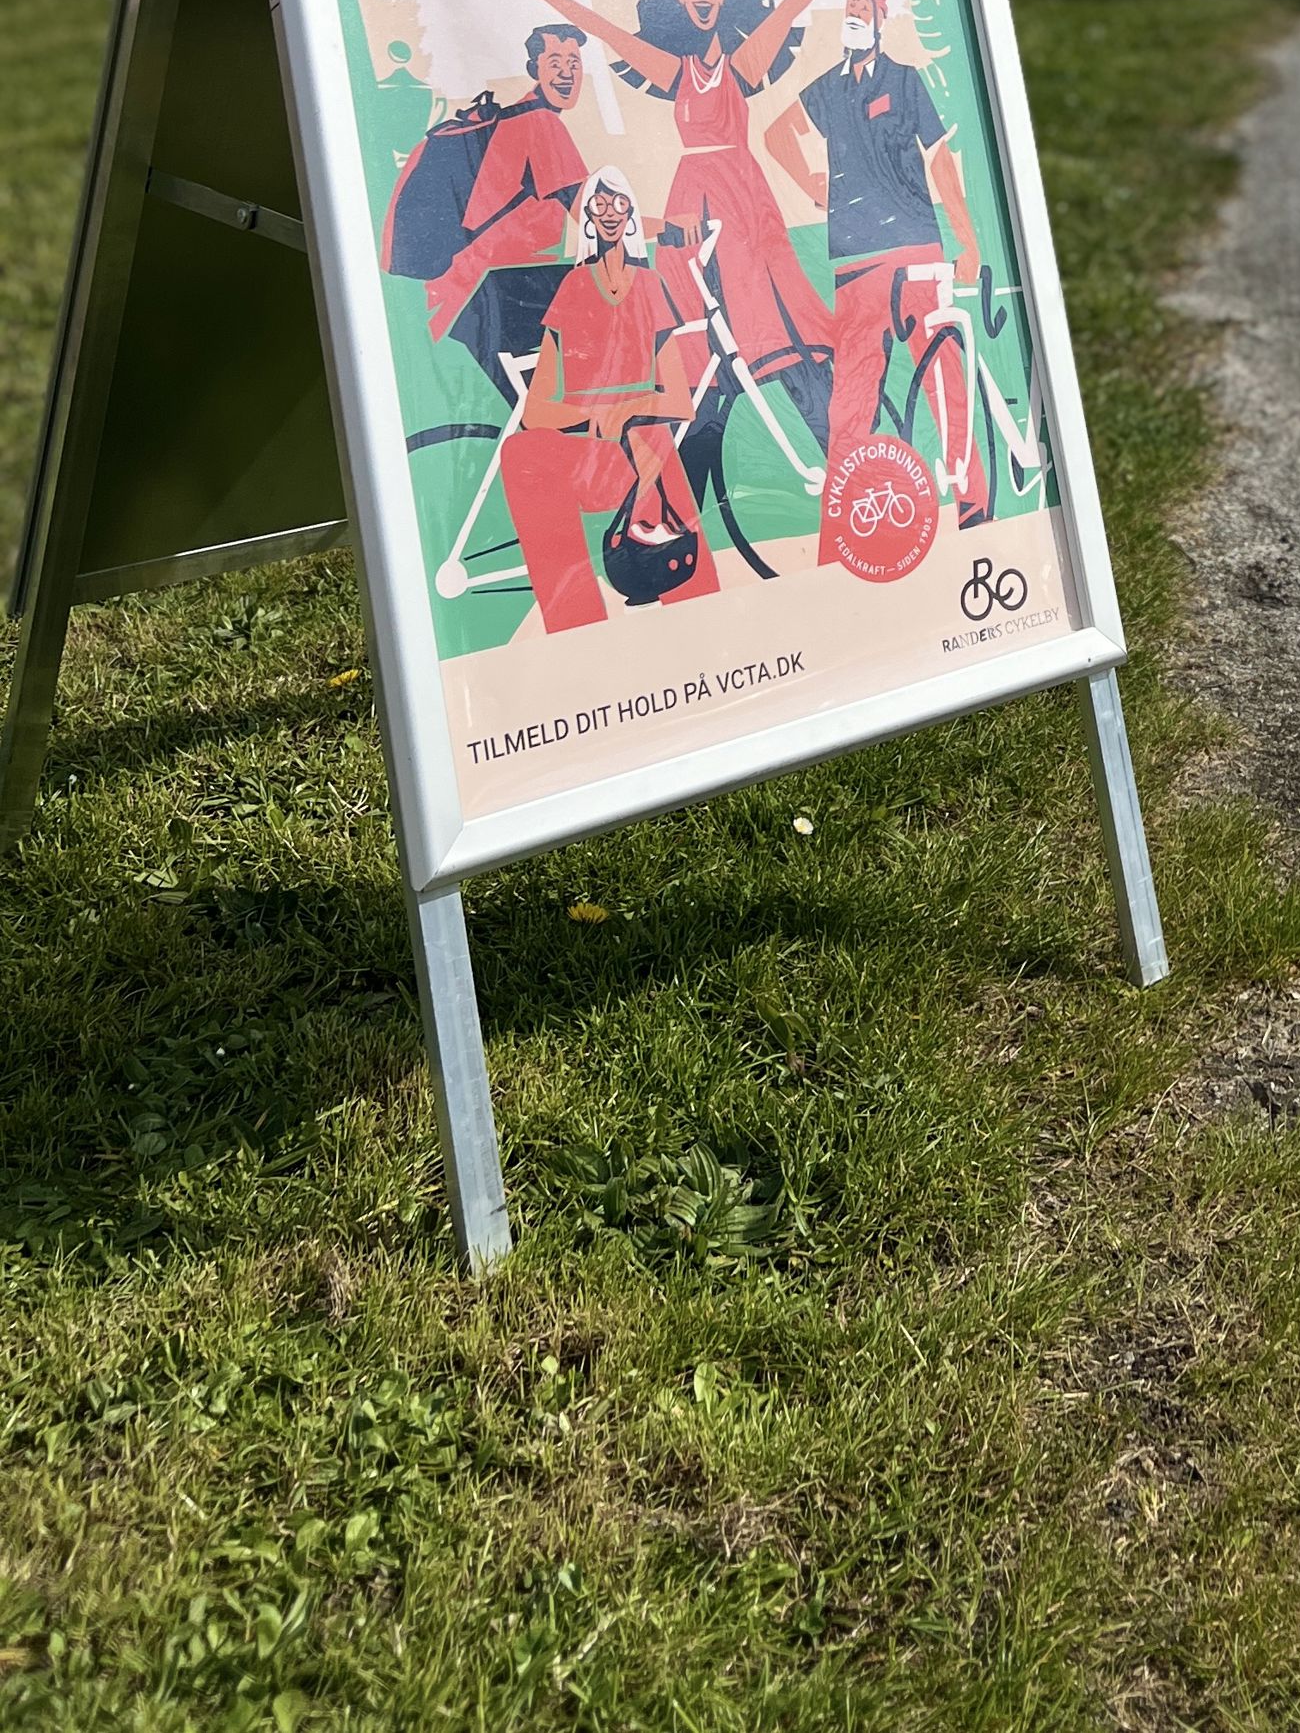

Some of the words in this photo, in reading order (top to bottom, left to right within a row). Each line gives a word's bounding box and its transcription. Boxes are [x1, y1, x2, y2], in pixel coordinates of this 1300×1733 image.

[828, 442, 932, 518] CYKLISTFORBUNDET
[834, 535, 887, 576] PEDALKRAFT
[896, 545, 922, 571] SIDEN
[919, 516, 933, 544] 1905
[941, 622, 1004, 653] RANDERS
[1004, 606, 1060, 635] CYKELBY
[467, 719, 570, 765] TILMELD
[576, 705, 612, 735] DIT
[617, 688, 679, 723] HOLD
[684, 673, 713, 705] PÅ
[716, 651, 806, 694] VCTA.DK
